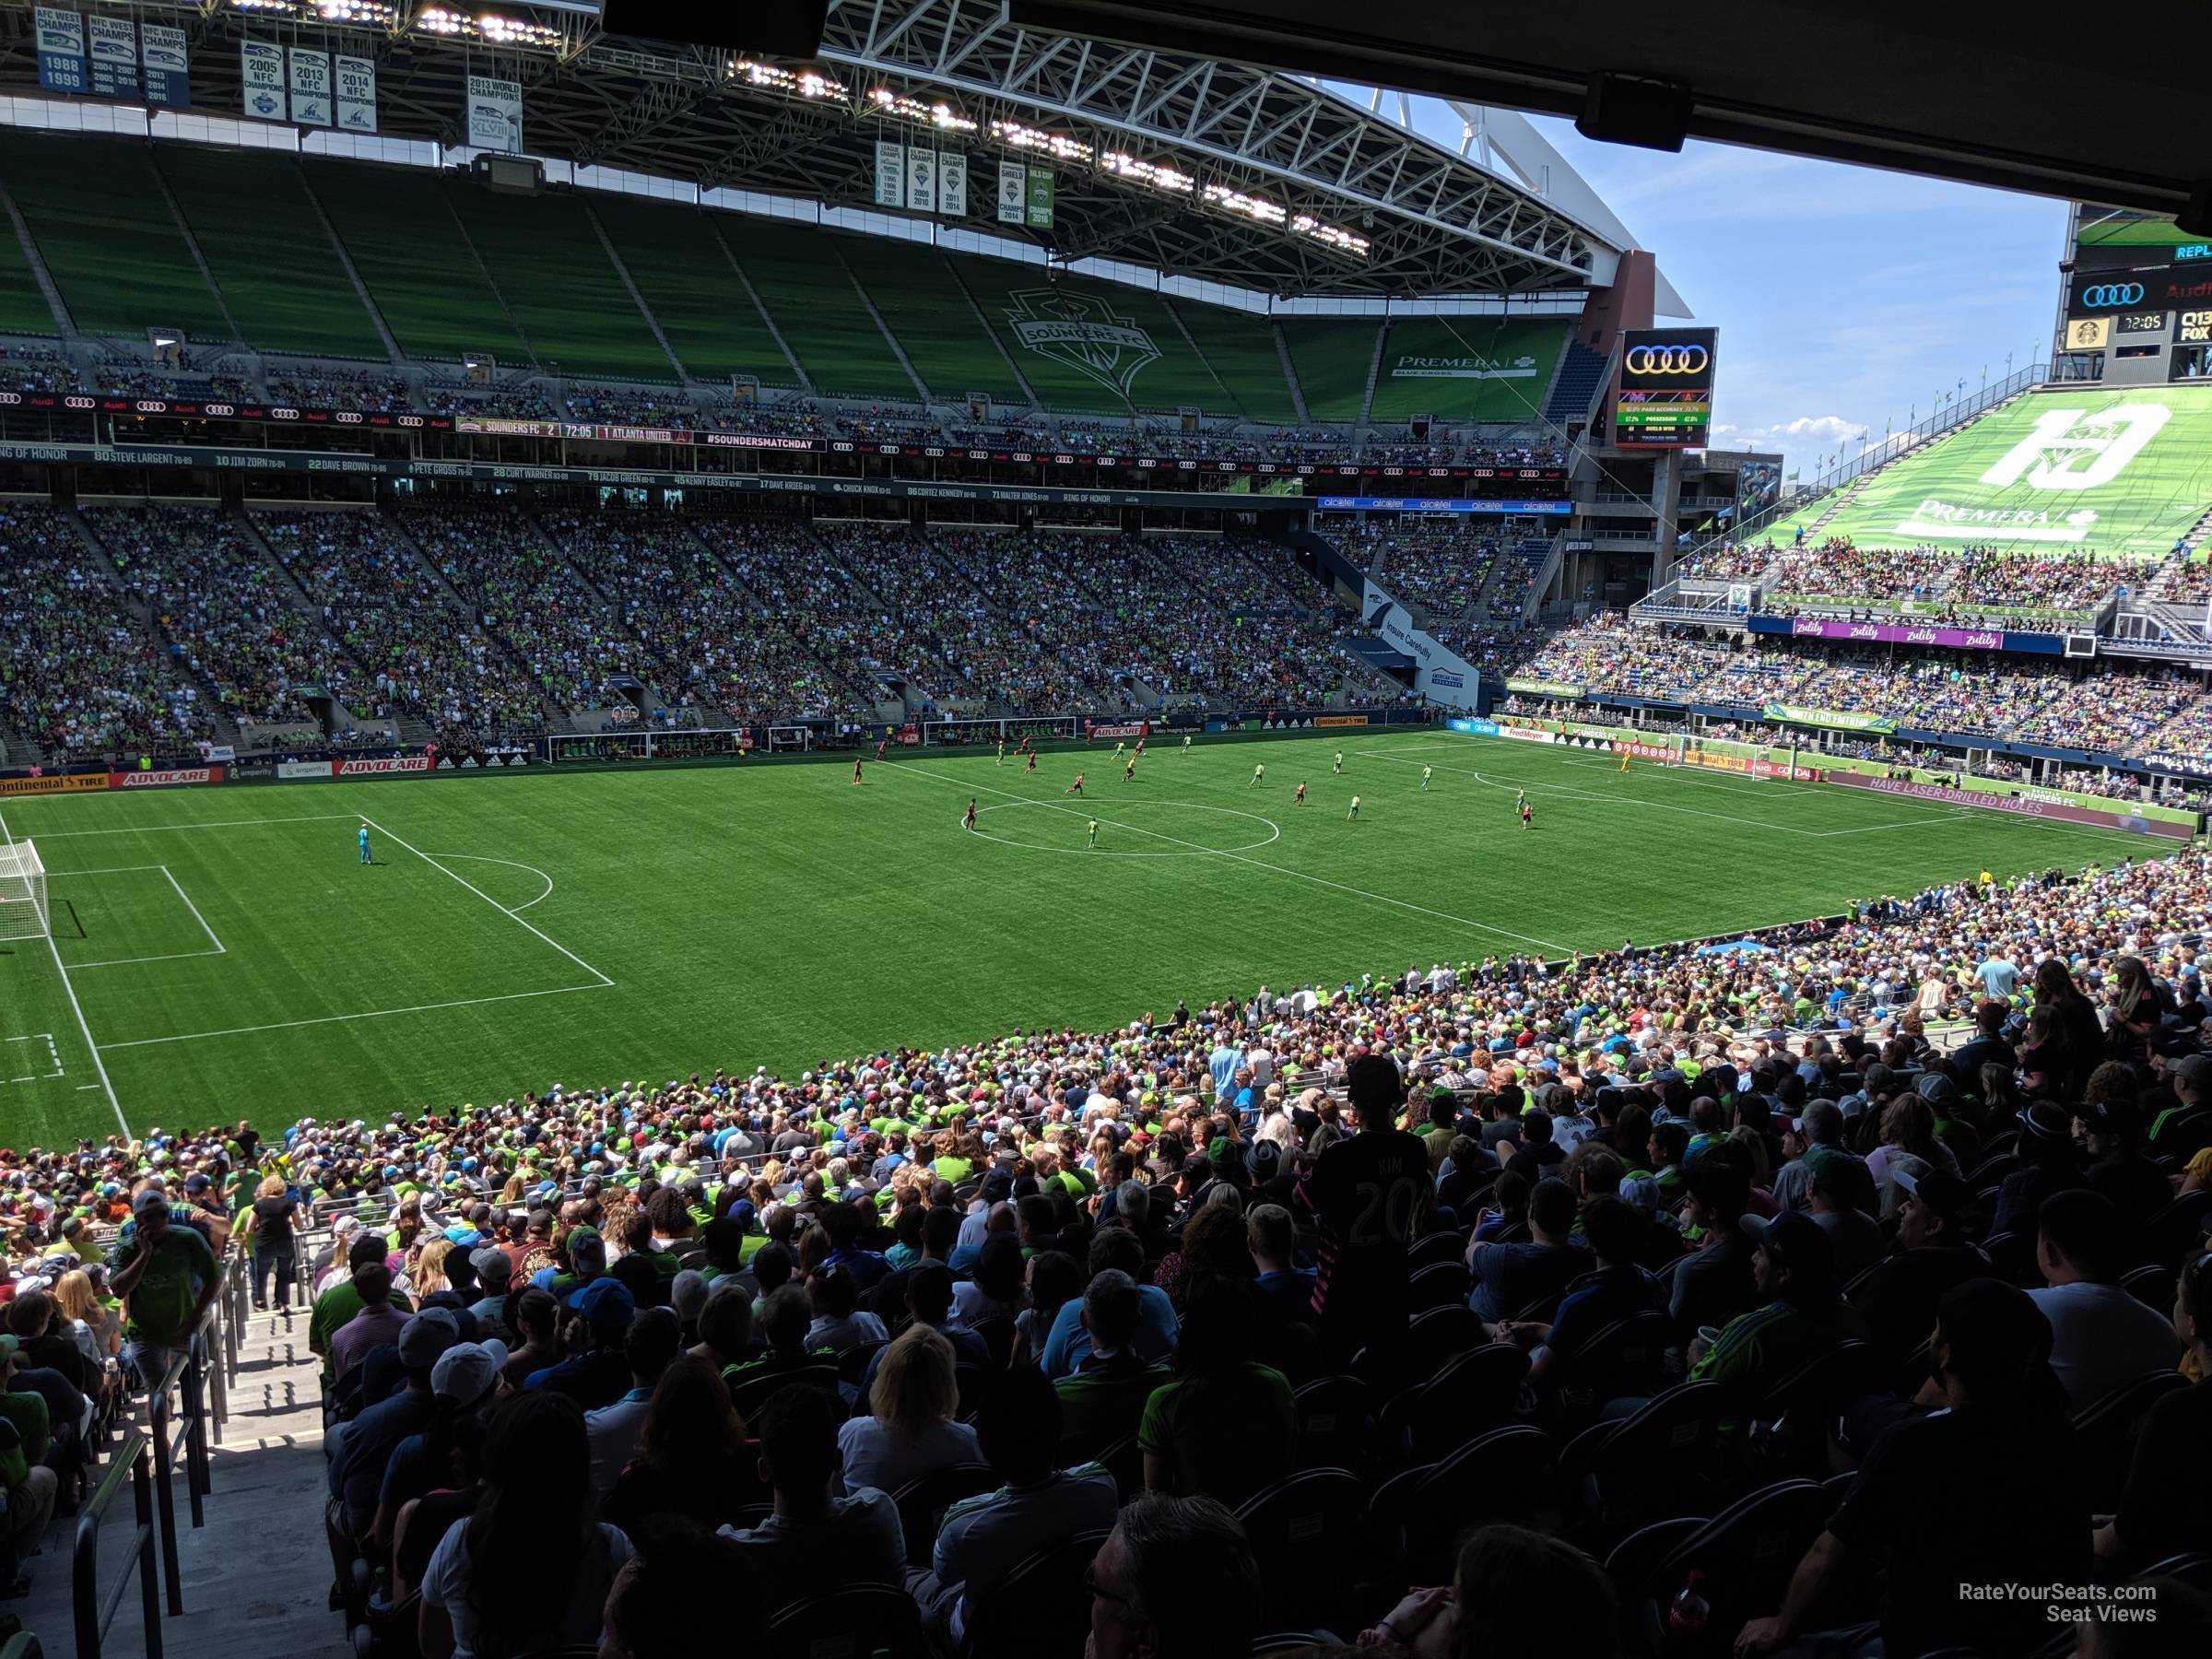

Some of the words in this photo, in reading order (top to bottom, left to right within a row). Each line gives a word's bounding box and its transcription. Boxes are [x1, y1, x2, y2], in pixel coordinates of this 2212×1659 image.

[38, 9, 53, 18] AFC
[55, 11, 79, 23] WEST
[38, 19, 81, 34] CHAMPS
[92, 18, 107, 28] NFC
[110, 20, 133, 31] WEST
[92, 27, 134, 42] CHAMPS
[143, 26, 159, 36] NFC
[161, 29, 184, 40] WEST
[144, 35, 184, 51] CHAMPS
[46, 57, 79, 72] 1988
[249, 59, 276, 74] 2005
[47, 72, 80, 87] 1999
[147, 70, 165, 79] 2013
[253, 72, 274, 83] NFC
[296, 66, 324, 81] 2013
[148, 81, 166, 90] 2014
[244, 80, 285, 93] CHAMPIONS
[300, 79, 321, 90] NFC
[342, 74, 369, 88] 2014
[470, 77, 490, 89] 2013
[491, 81, 520, 93] WORLD
[291, 88, 331, 100] CHAMPIONS
[347, 87, 366, 97] NFC
[470, 87, 520, 102] CHAMPIONS
[337, 95, 376, 107] CHAMPIONS
[471, 120, 508, 136] XLVIII
[910, 154, 934, 164] CHAMPS
[941, 159, 965, 169] CHAMPS
[1001, 170, 1024, 180] SHIELD
[999, 204, 1024, 213] CHAMPS
[1026, 328, 1118, 342] SOUNDERS
[1121, 334, 1146, 347] FC
[2181, 327, 2211, 341] FOX
[1397, 356, 1501, 369] PREMERA
[29, 397, 54, 406] Audi
[103, 401, 128, 410] Audi
[174, 405, 197, 414] Audi
[307, 412, 328, 421] Audi
[369, 416, 390, 425] Audi
[429, 419, 450, 429] Audi
[486, 420, 528, 434] SOUNDERS
[529, 423, 540, 434] FC
[547, 425, 554, 436] 2
[565, 425, 592, 438] 72:05
[604, 428, 609, 439] 1
[612, 428, 644, 441] ATLANTA
[645, 429, 671, 441] UNITED
[707, 434, 813, 450] #SOUNDERSMATCHDAY
[16, 448, 29, 459] OF
[31, 449, 68, 460] HONOR
[94, 451, 111, 461] 80
[110, 452, 136, 462] STEVE
[137, 453, 173, 465] LARGENT
[215, 455, 229, 465] 10
[229, 456, 246, 467] JIM
[247, 457, 269, 468] ZORN
[308, 460, 323, 469] 22
[323, 461, 341, 471] DAVE
[342, 462, 370, 472] BROWN
[415, 465, 432, 475] PETE
[433, 465, 457, 475] GROSS
[493, 468, 506, 477] 28
[506, 468, 524, 478] CURT
[524, 469, 553, 479] WARNER
[588, 472, 599, 481] 79
[599, 473, 619, 483] JACOB
[620, 474, 641, 483] GREEN
[675, 476, 686, 485] 45
[686, 477, 706, 487] KENNY
[707, 477, 729, 488] EASLEY
[759, 479, 769, 488] 17
[769, 480, 784, 490] DAVE
[784, 481, 804, 491] KRIEG
[842, 484, 863, 493] CHUCK
[863, 485, 879, 494] KNOX
[907, 487, 918, 496] 96
[917, 488, 938, 497] CORTEZ
[938, 488, 964, 498] KENNEDY
[992, 490, 1001, 500] 71
[1000, 491, 1021, 500] WALTER
[1021, 492, 1038, 500] JONES
[1064, 493, 1080, 502] RING
[1080, 494, 1088, 502] OF
[1089, 494, 1112, 503] HONOR
[1324, 498, 1355, 507] alcatel
[1372, 499, 1404, 508] alcatel
[1419, 500, 1452, 509] alcatel
[1471, 501, 1503, 510] alcatel
[1523, 502, 1556, 511] alcatel
[1911, 500, 2052, 524] PREMERA
[1386, 619, 1405, 641] Insure
[1405, 634, 1431, 662] Carefully
[1315, 715, 1348, 727] Continental
[1817, 713, 1830, 723] END
[1094, 725, 1141, 737] ADVOCARE
[295, 765, 326, 774] amperity
[341, 757, 429, 775] ADVOCARE
[123, 768, 209, 786] ADVOCARE
[241, 768, 272, 778] amperity
[76, 776, 105, 786] TIRE
[1870, 777, 1900, 791] HAVE
[1903, 782, 1997, 807] LASER-DRILLED
[1999, 795, 2045, 815] HOLES
[1379, 1157, 1403, 1174] KIM
[1349, 1177, 1418, 1244] 20
